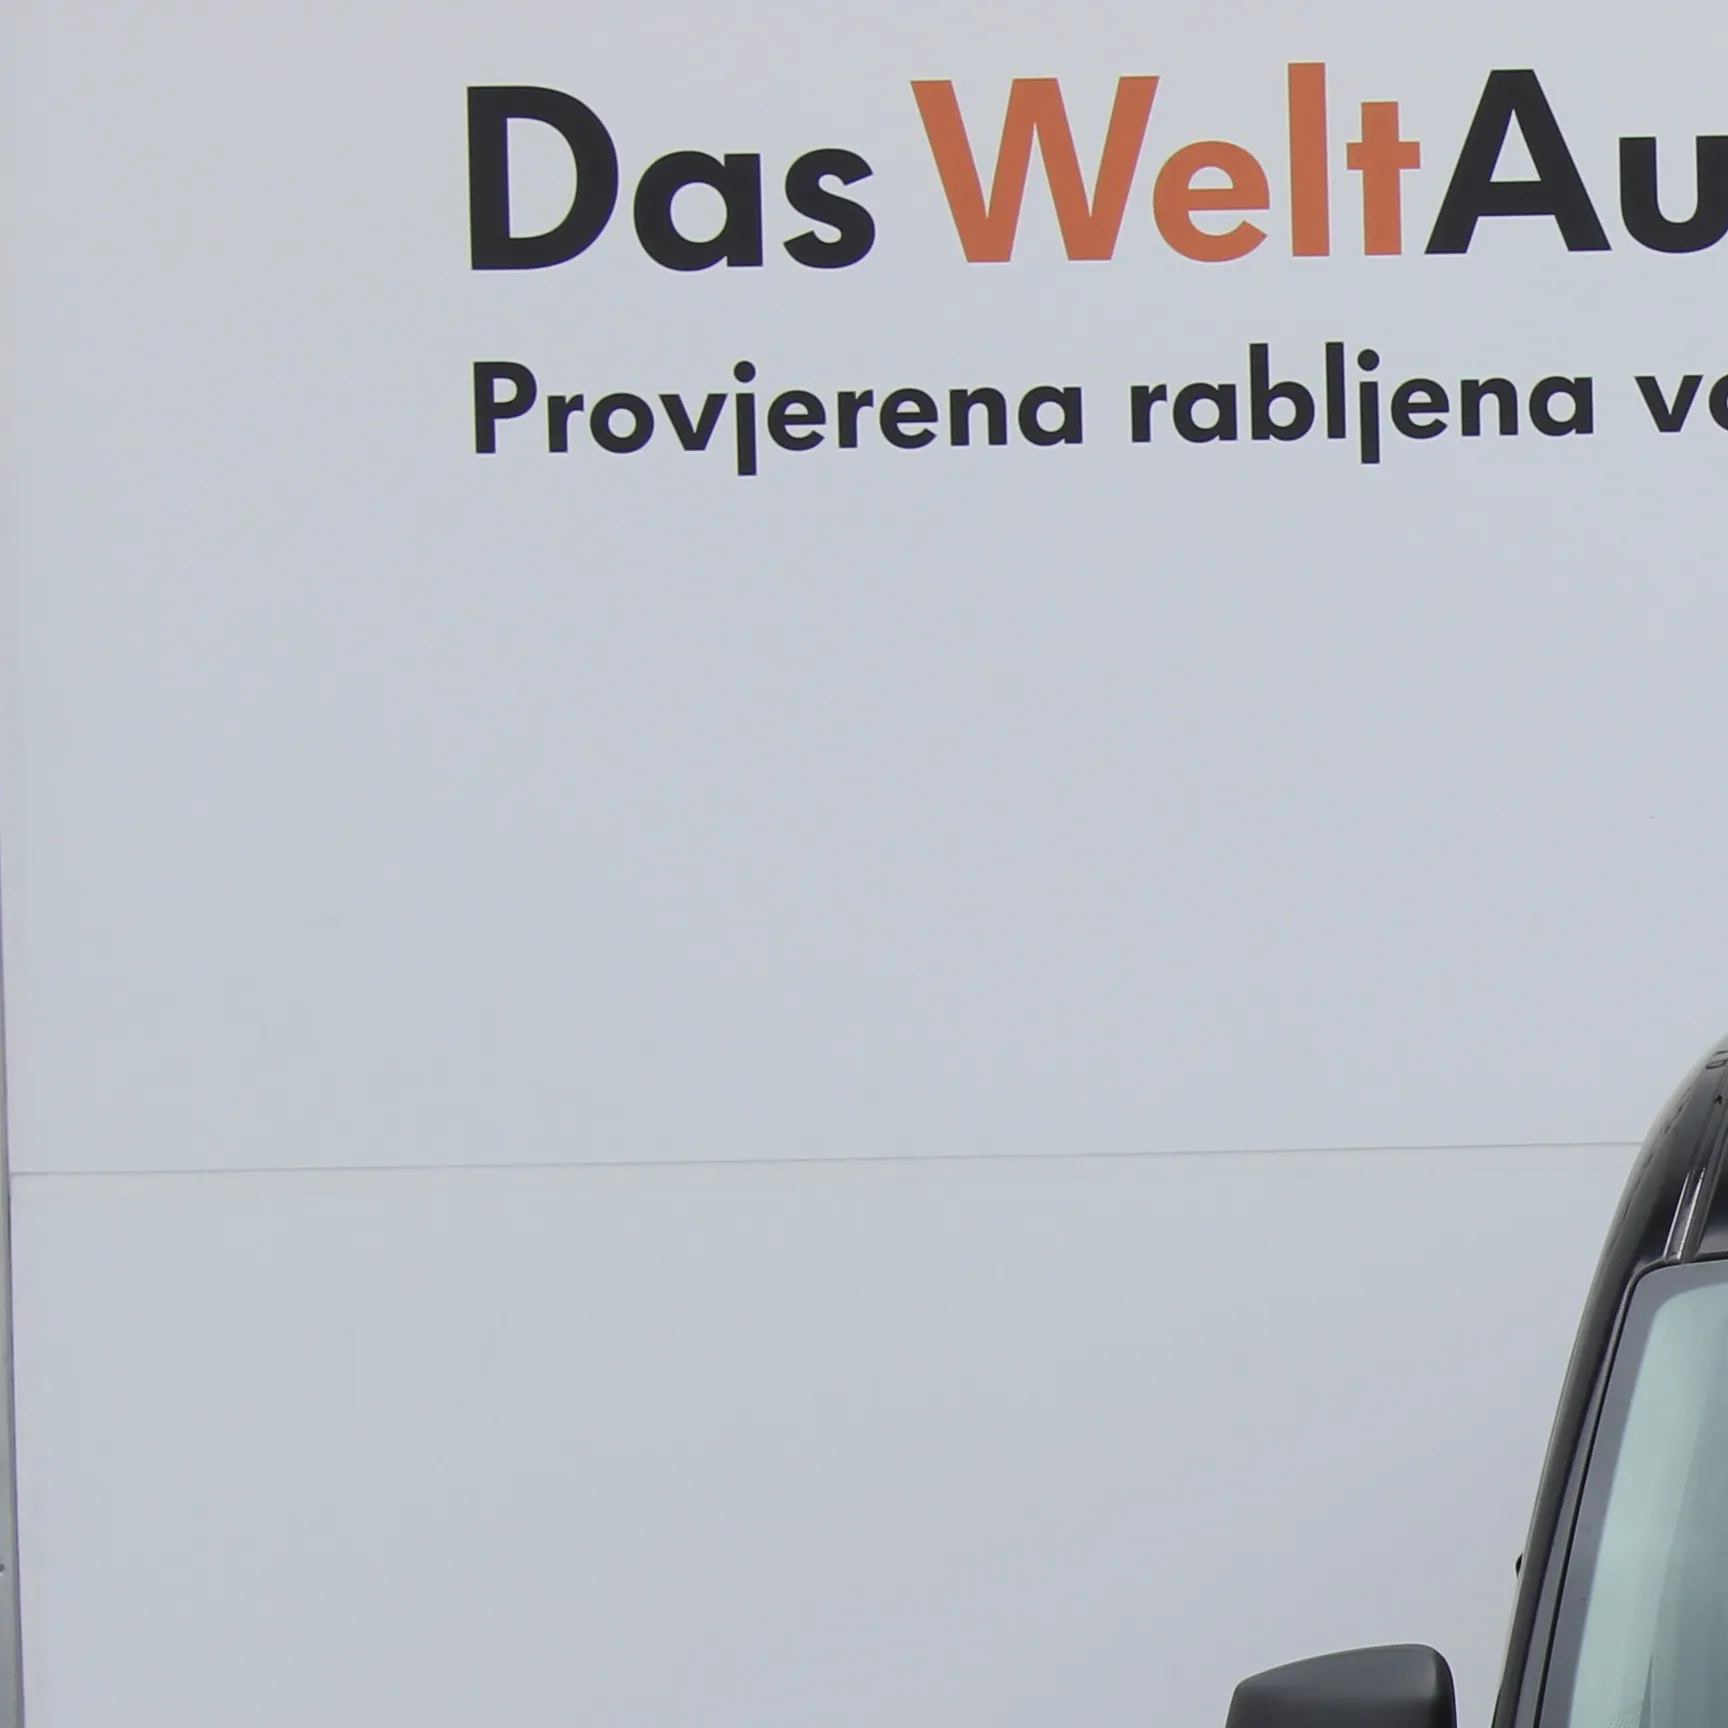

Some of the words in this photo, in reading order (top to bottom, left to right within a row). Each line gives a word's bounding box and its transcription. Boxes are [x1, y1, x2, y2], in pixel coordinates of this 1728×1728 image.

[465, 84, 877, 272] Das
[472, 360, 1084, 478] Provjerena
[1129, 340, 1595, 466] rabljena
